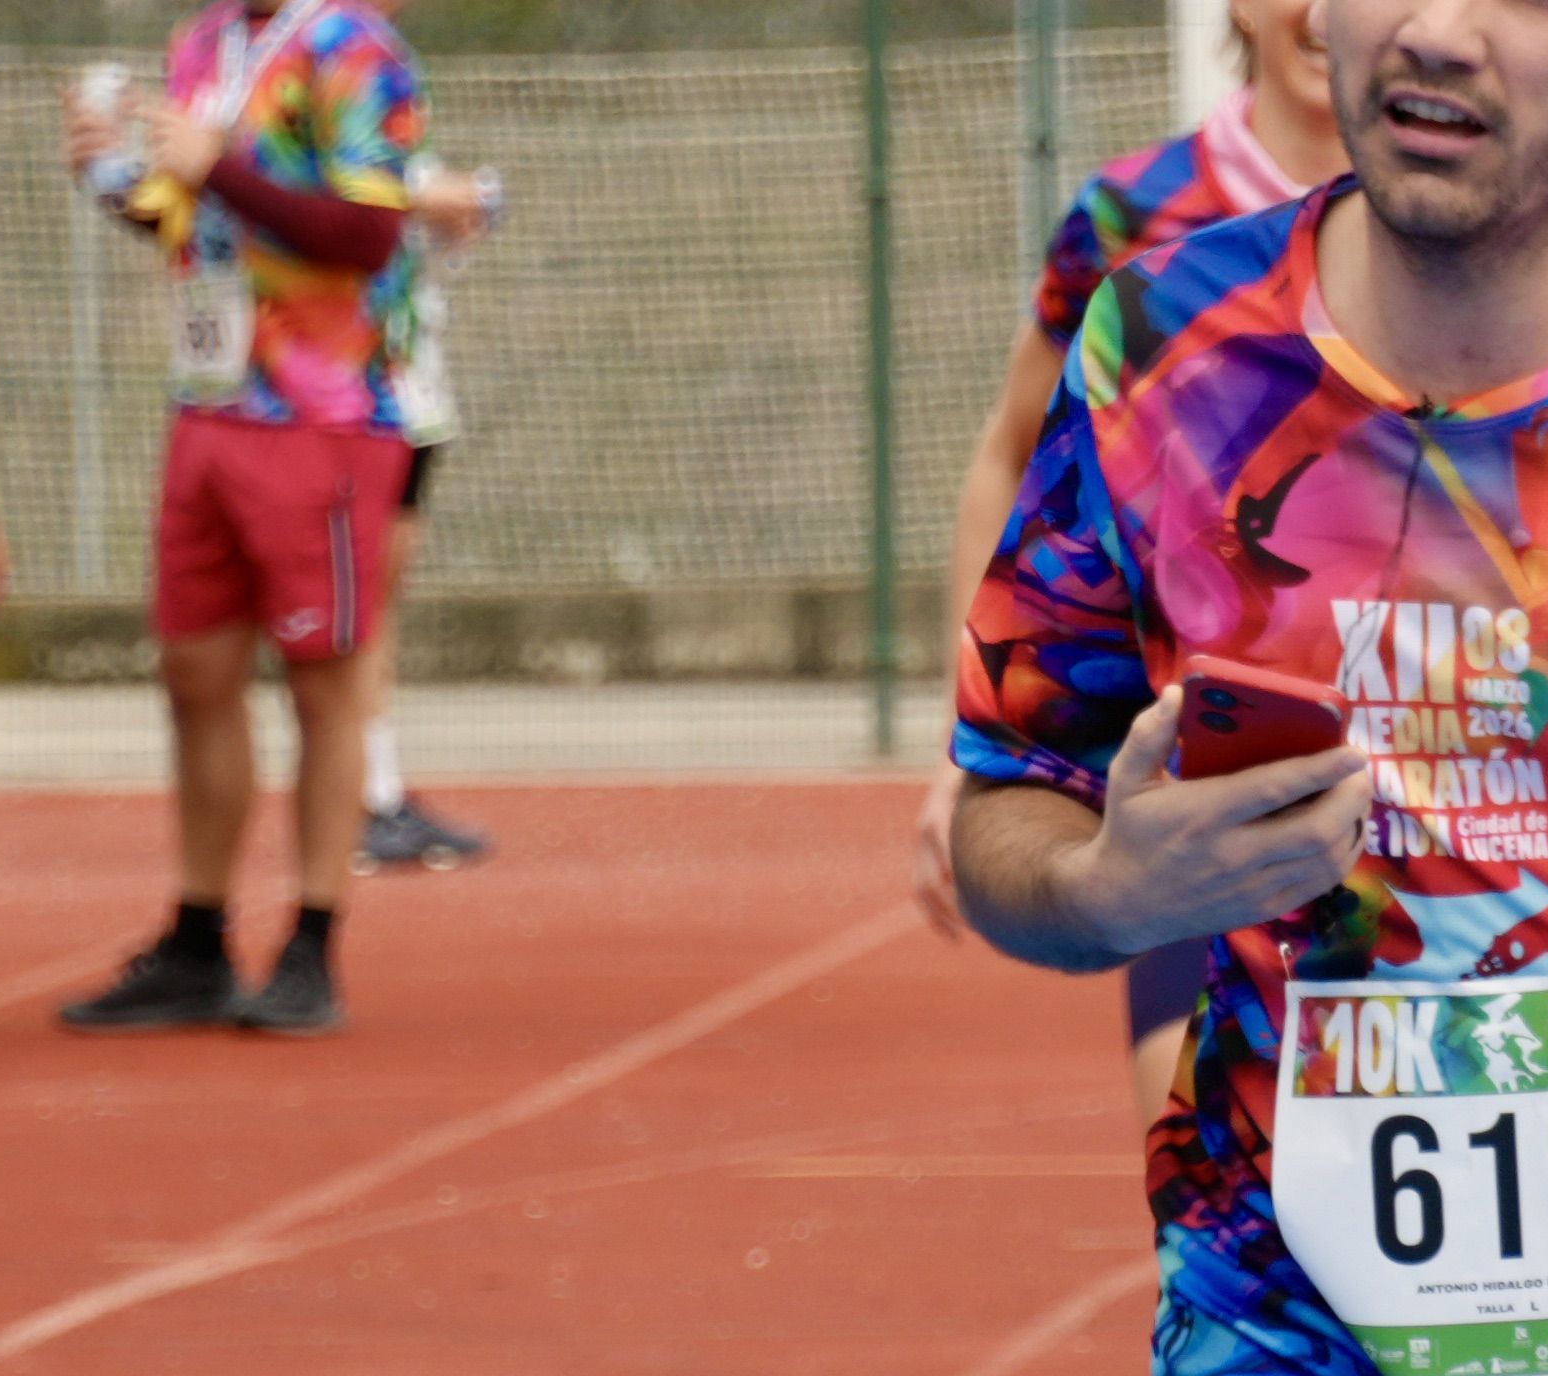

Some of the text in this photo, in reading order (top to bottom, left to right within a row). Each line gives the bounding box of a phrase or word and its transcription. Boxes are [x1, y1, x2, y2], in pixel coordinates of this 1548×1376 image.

[1330, 599, 1531, 704] XII 08
[1463, 677, 1531, 705] MARZO
[1467, 706, 1535, 741] 2026
[1365, 747, 1547, 810] ARATÓN
[1457, 809, 1548, 838] Ciudad de
[1324, 1000, 1446, 1095] 10K
[1416, 1281, 1478, 1294] ANTONIO
[1482, 1278, 1543, 1292] HIDALGO
[1476, 1301, 1539, 1314] TALLA L
